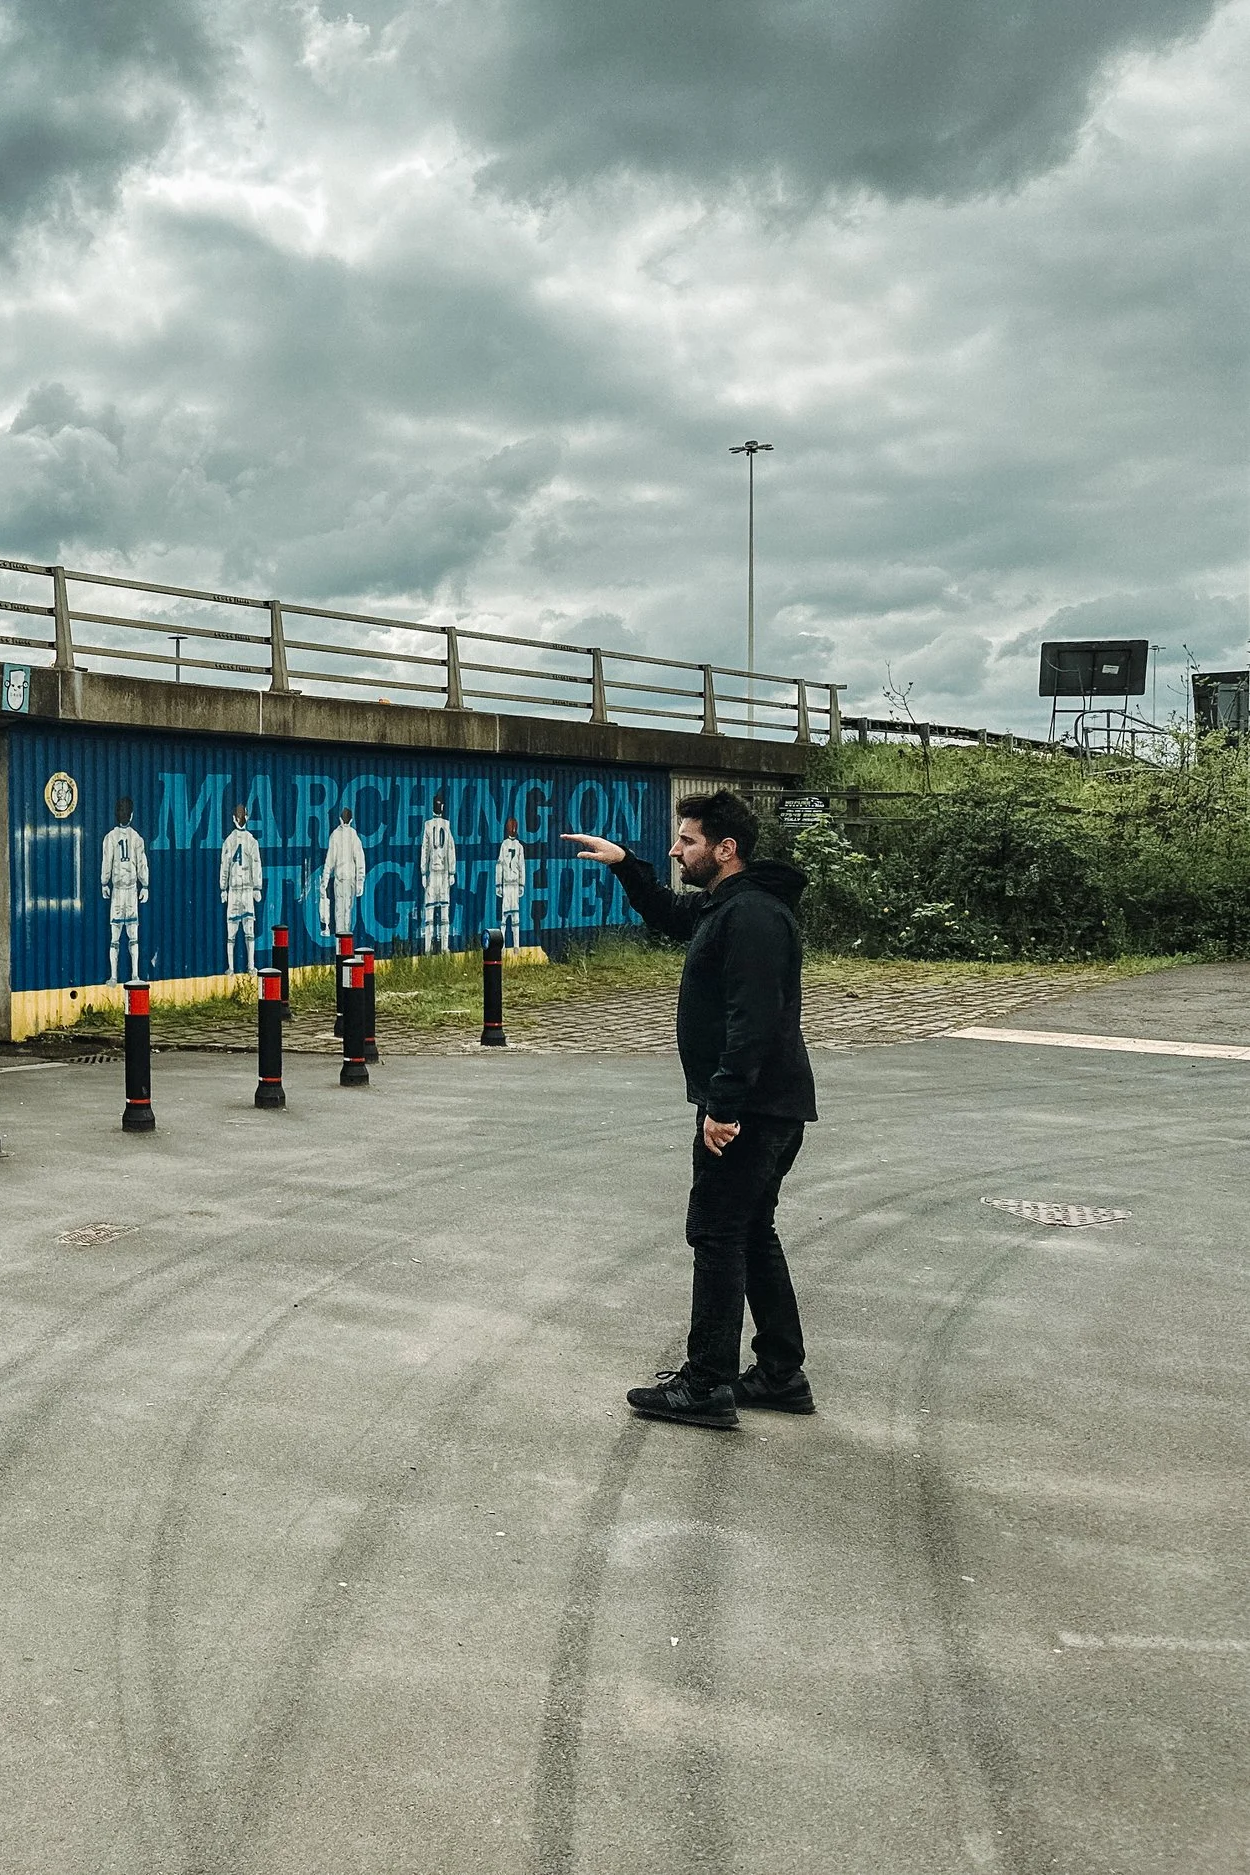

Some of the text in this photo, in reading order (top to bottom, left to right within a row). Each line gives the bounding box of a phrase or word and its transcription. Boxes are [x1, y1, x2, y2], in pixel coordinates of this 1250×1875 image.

[150, 772, 553, 850] MARCHING
[567, 779, 648, 842] ON
[232, 844, 243, 867] 4
[507, 848, 516, 870] 7
